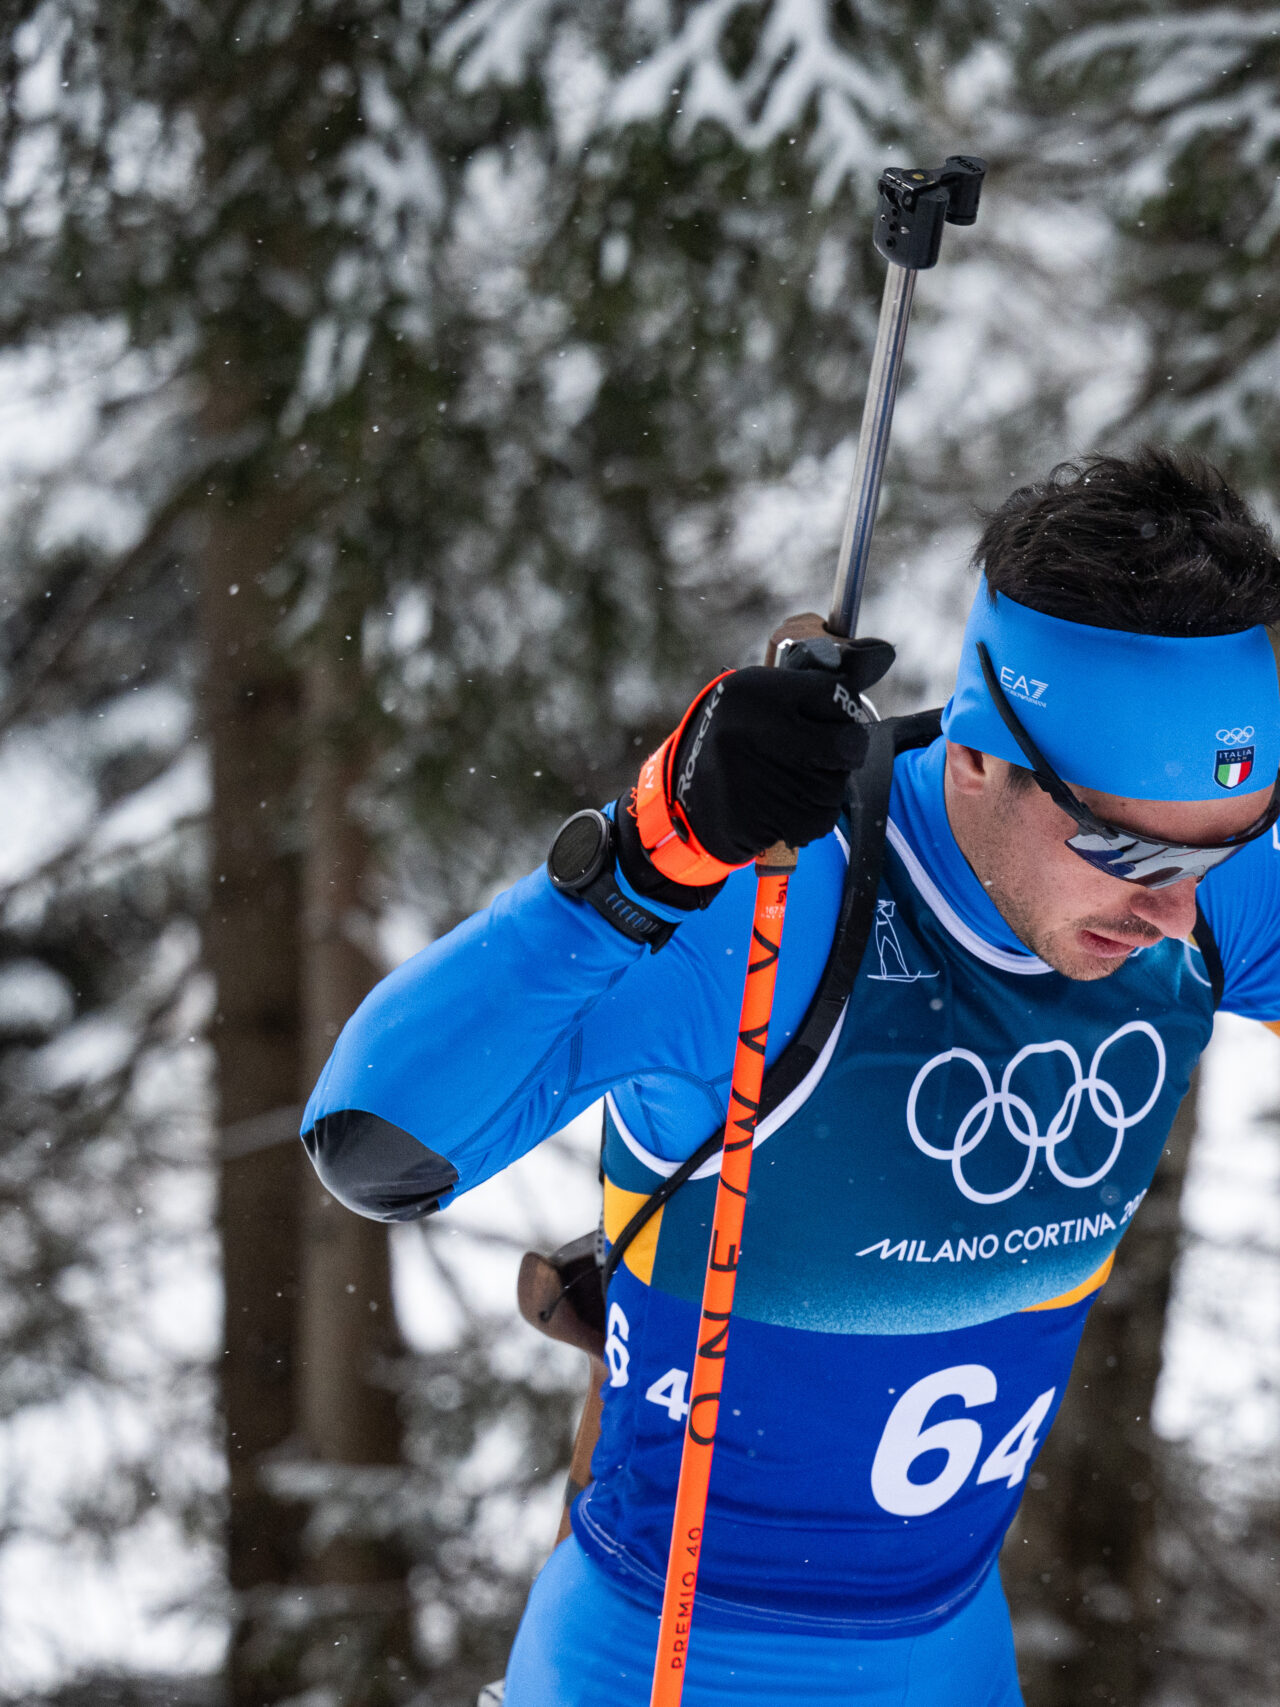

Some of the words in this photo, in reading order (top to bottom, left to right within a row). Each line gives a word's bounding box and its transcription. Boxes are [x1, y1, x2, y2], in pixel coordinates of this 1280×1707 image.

[1001, 666, 1049, 699] EA7
[1219, 749, 1252, 759] ITALIA
[855, 1238, 999, 1262] MILANO
[1004, 1212, 1116, 1254] CORTINA
[871, 1364, 1056, 1517] 64
[671, 1571, 696, 1669] PREMIO
[687, 1527, 701, 1557] 40
